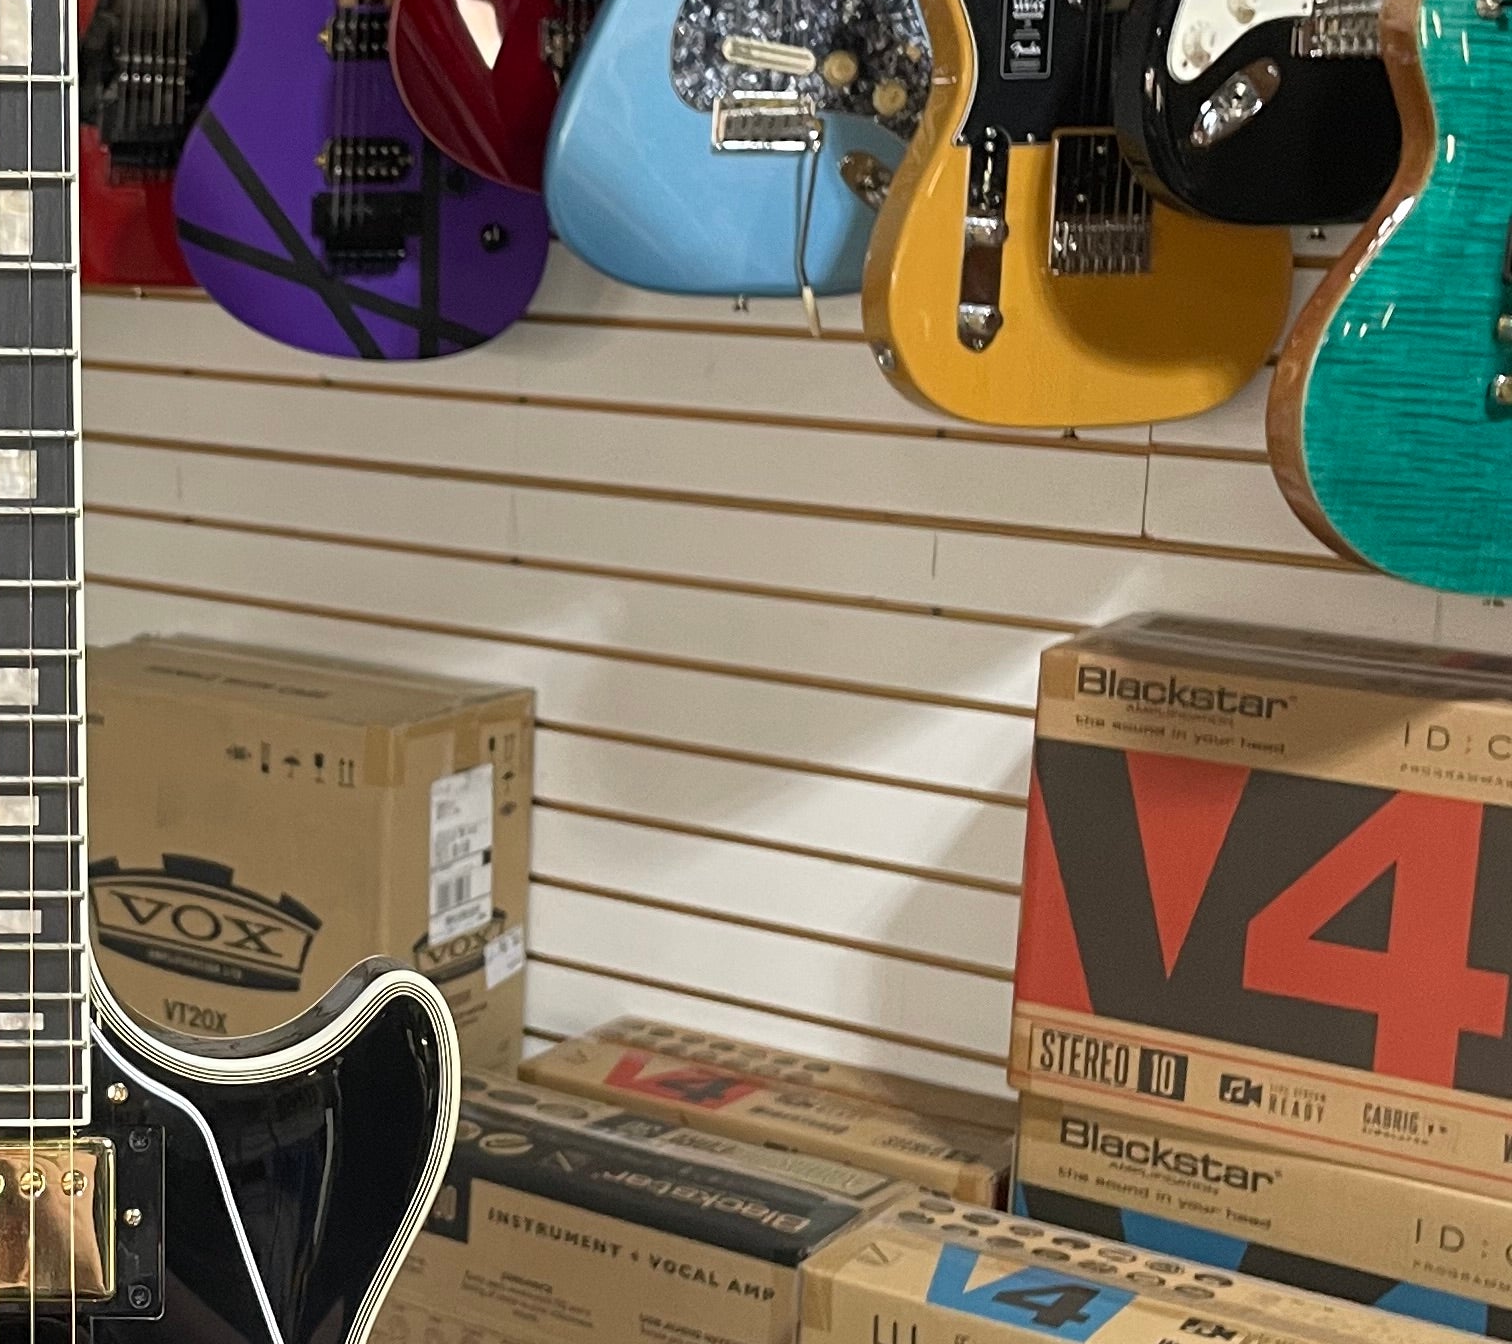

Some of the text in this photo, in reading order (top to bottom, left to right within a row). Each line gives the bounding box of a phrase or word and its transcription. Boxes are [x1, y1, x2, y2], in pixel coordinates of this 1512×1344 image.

[1078, 665, 1288, 719] Blackstar
[109, 889, 283, 959] VOX
[162, 997, 229, 1036] VT20X
[1039, 1029, 1176, 1093] STEREO 10
[1060, 1117, 1274, 1193] Blackstar
[487, 1206, 623, 1258] INSTRUMENT
[649, 1251, 720, 1289] VOCAL
[726, 1278, 776, 1302] AMP
